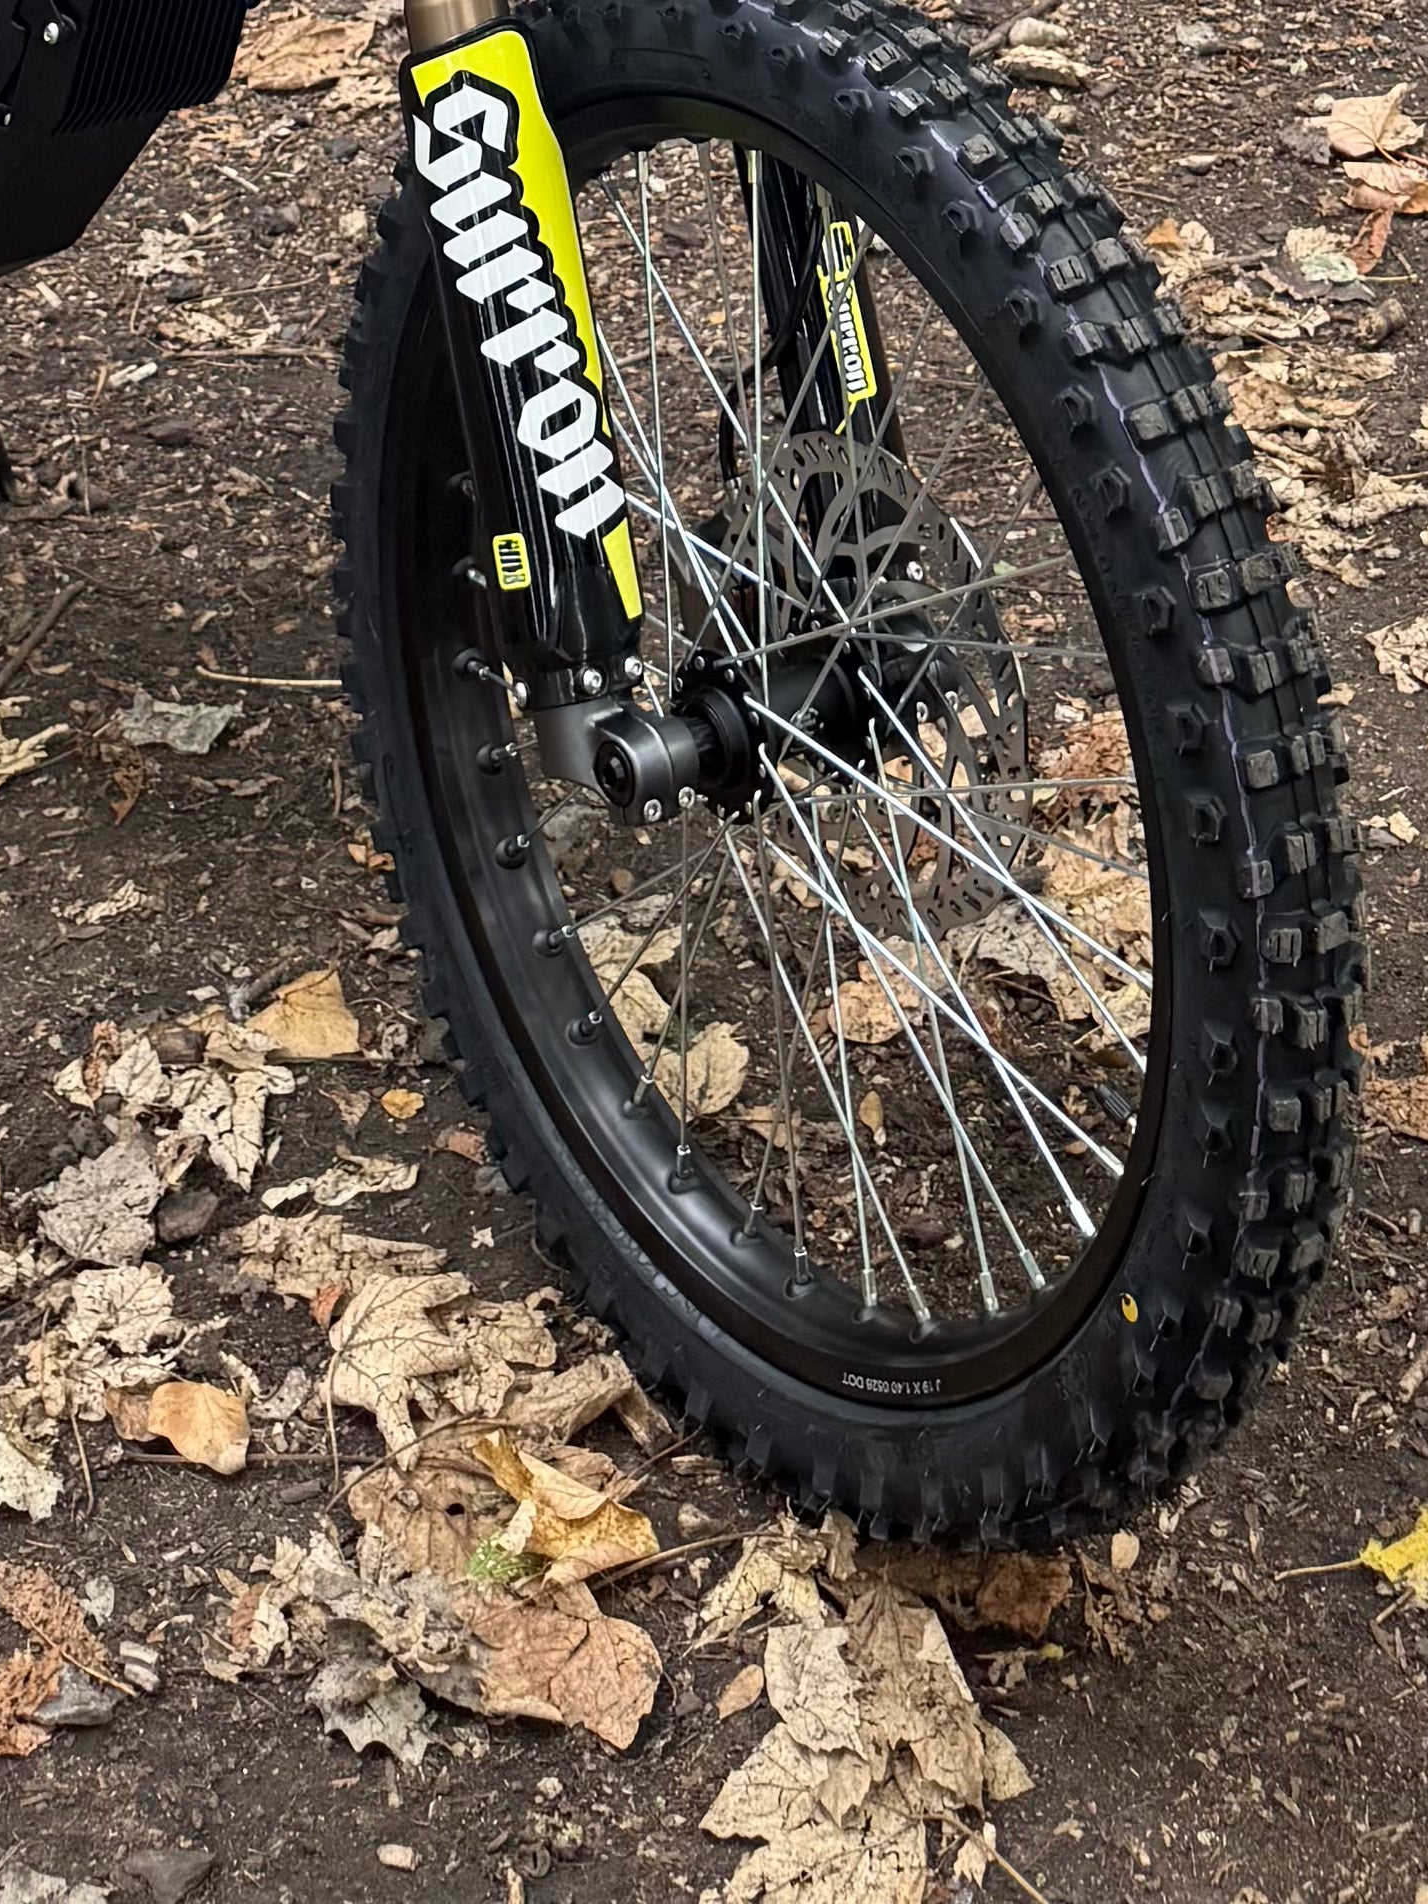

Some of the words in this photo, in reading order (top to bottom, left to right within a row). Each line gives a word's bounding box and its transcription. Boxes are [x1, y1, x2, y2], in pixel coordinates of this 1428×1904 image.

[841, 1371, 864, 1389] DOT
[922, 1380, 933, 1393] 19
[891, 1381, 910, 1394] 1.40
